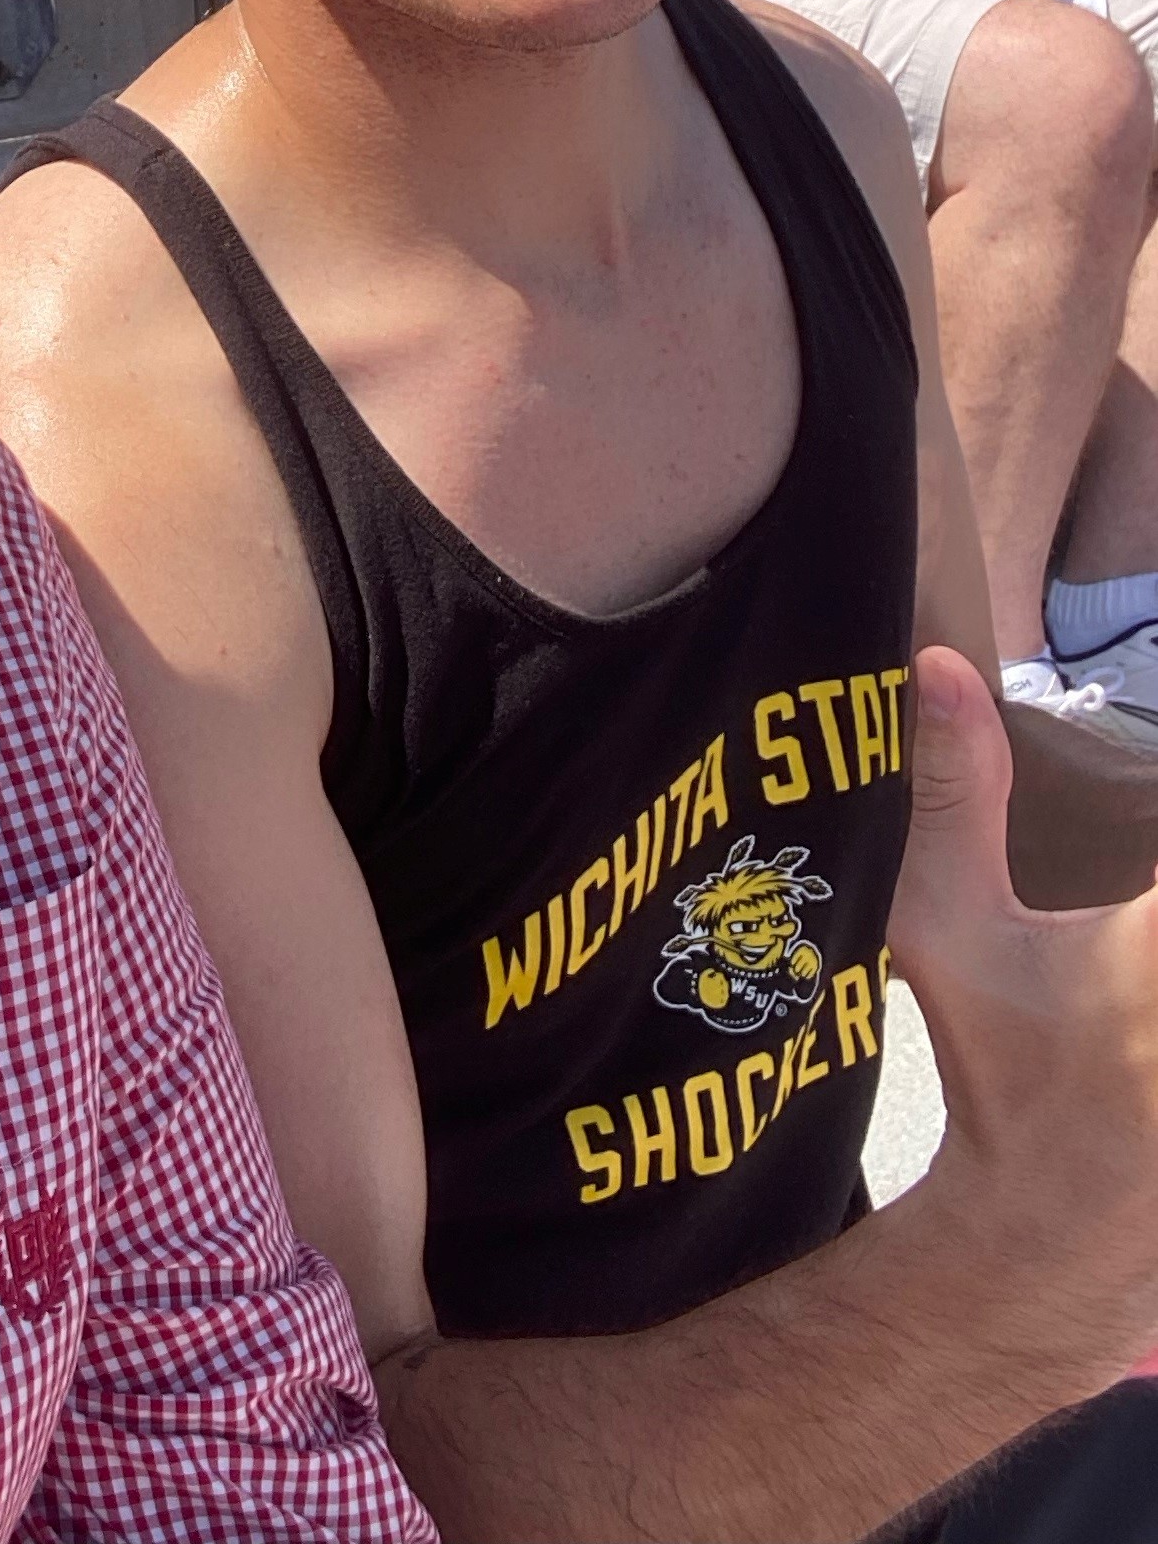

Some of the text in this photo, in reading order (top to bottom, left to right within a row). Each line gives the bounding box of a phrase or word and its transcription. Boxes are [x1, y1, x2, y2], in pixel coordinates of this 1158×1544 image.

[482, 665, 909, 1030] WICHITA STAT
[730, 977, 770, 1009] WSU
